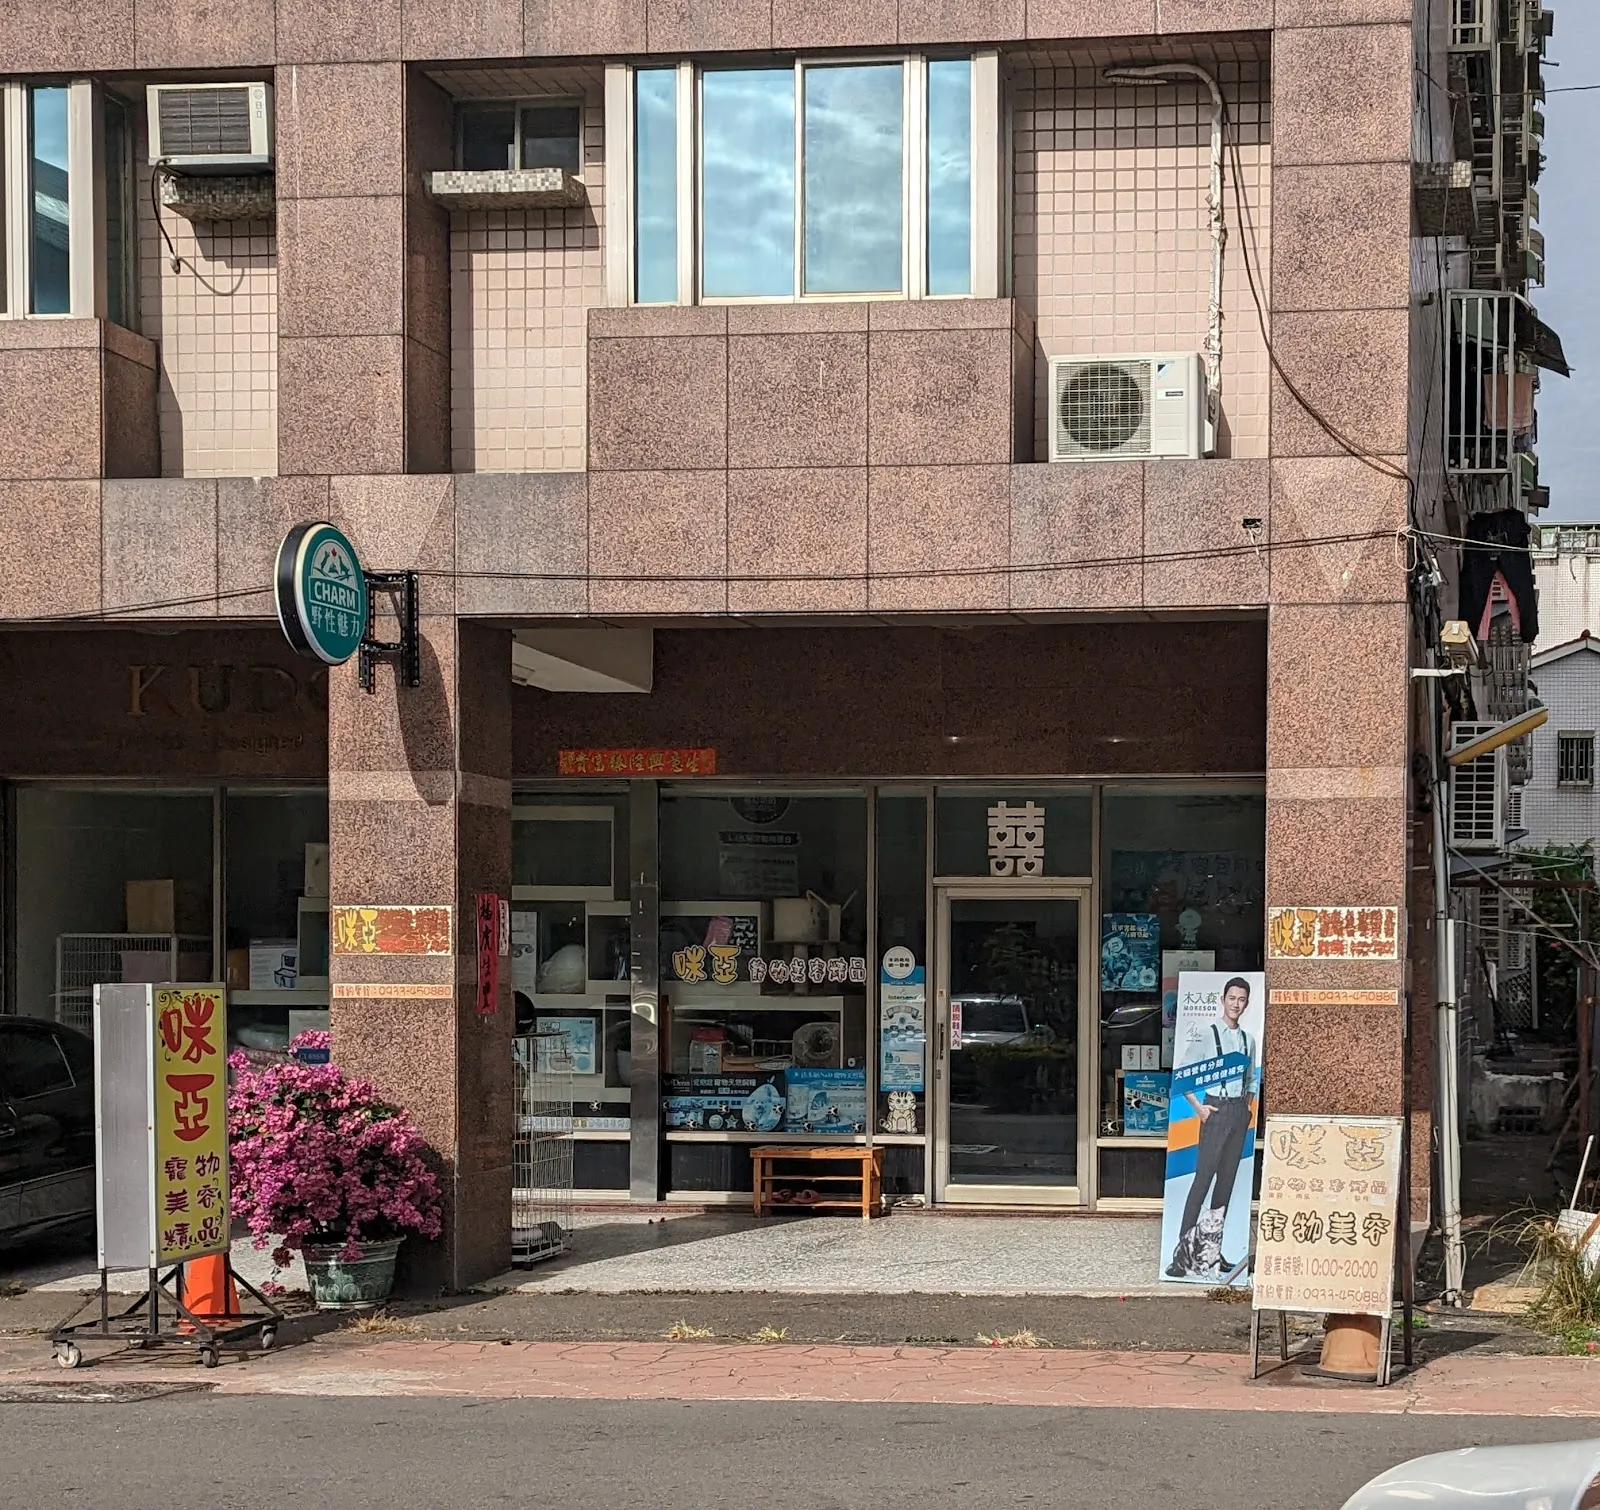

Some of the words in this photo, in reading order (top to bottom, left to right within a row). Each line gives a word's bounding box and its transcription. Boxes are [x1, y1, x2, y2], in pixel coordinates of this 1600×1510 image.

[314, 581, 356, 609] CHARM
[311, 606, 360, 638] 野性魅力
[338, 908, 378, 953] 咪亞
[1273, 908, 1318, 957] 咪亞
[672, 944, 741, 985] 咪亞
[1183, 991, 1218, 1005] 木入森
[162, 996, 217, 1142] 咪亞
[164, 1151, 221, 1182] 寵物
[164, 1185, 219, 1215] 美容
[164, 1216, 221, 1248] 精品
[1260, 1208, 1391, 1247] 寵物美容
